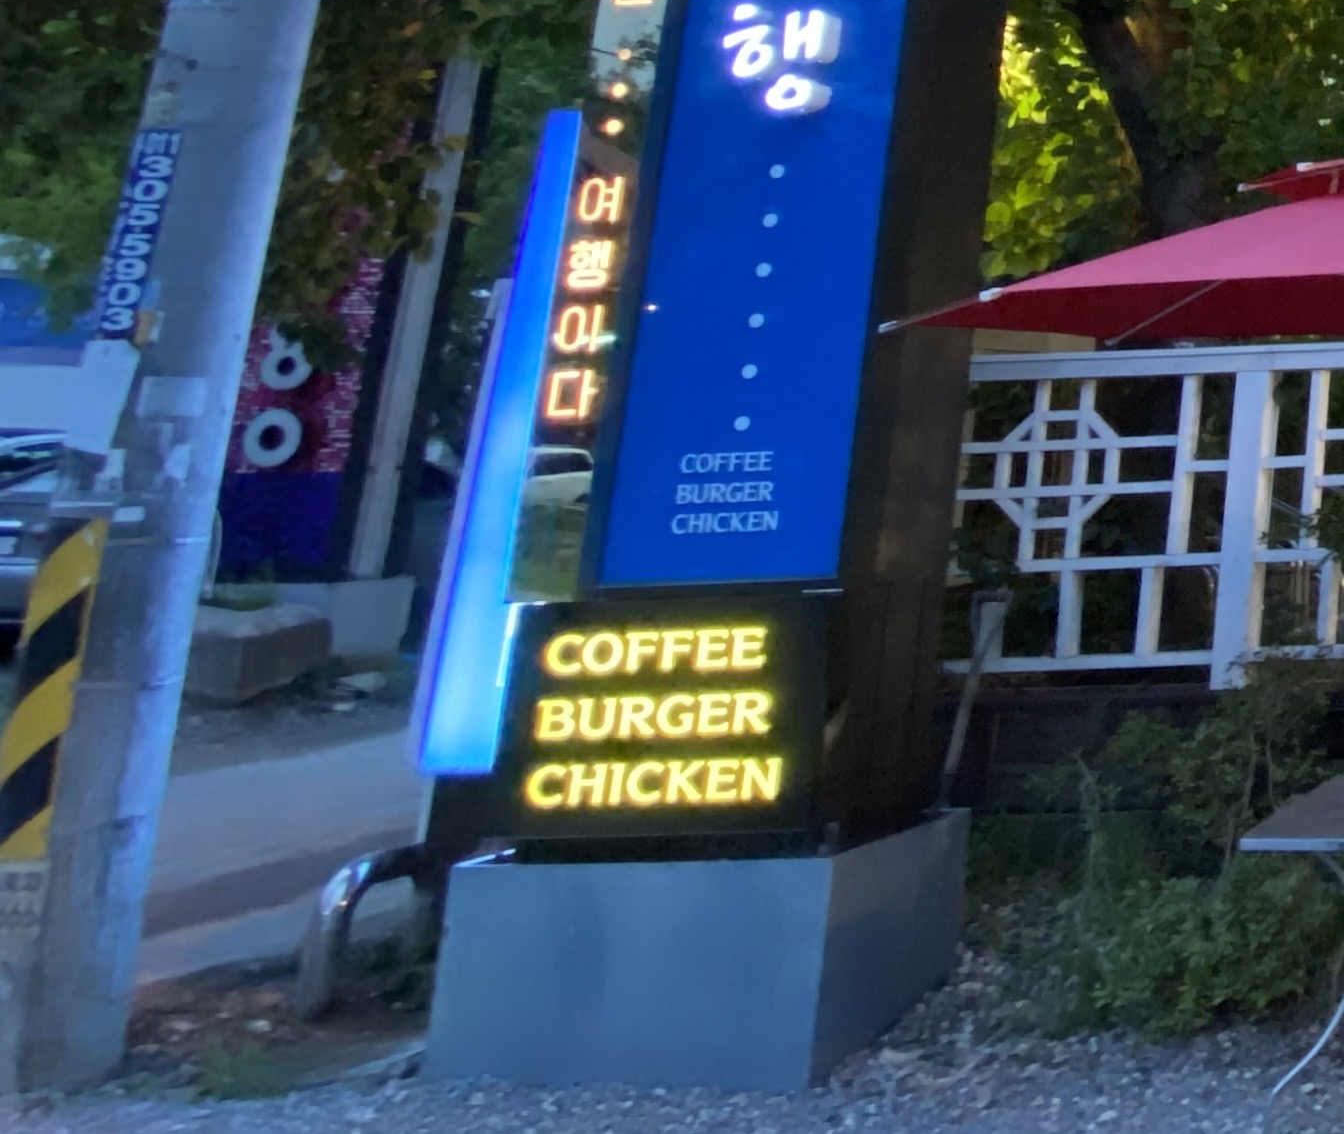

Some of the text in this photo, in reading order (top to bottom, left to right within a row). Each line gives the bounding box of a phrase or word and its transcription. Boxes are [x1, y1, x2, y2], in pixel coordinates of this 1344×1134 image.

[545, 174, 625, 421] 여행이다
[680, 451, 774, 474] COFFEE
[675, 481, 774, 504] BURGER
[671, 511, 779, 535] CHICKEN
[544, 625, 768, 677] COFFEE
[535, 692, 772, 742] BURGER
[526, 757, 783, 809] CHICKEN
